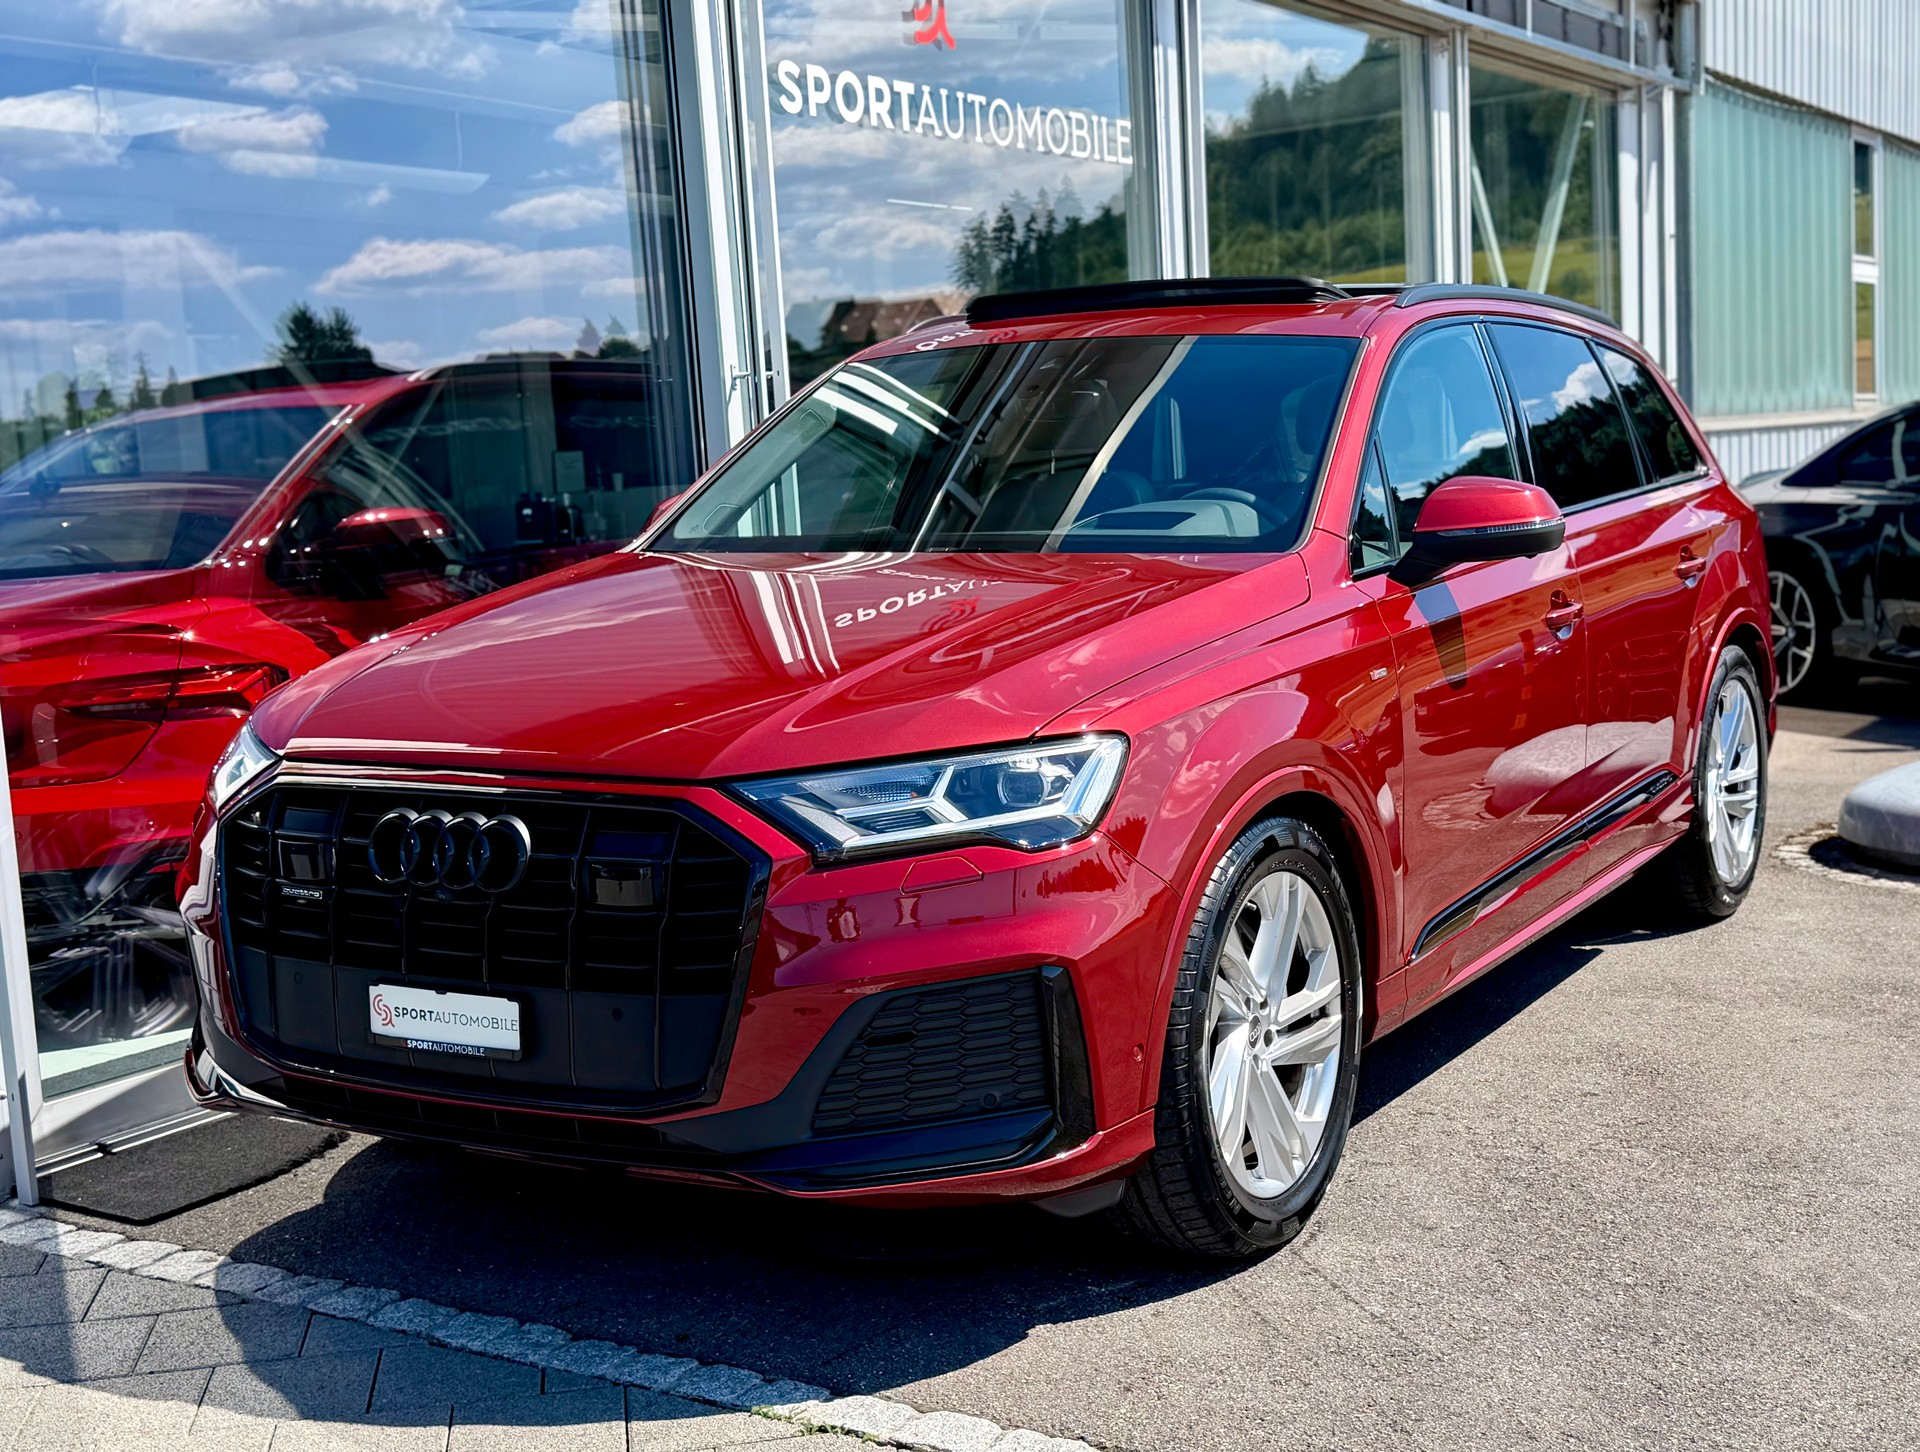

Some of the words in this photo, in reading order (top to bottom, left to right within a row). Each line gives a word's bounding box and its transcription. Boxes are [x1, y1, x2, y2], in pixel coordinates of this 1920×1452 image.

[776, 59, 1132, 165] SPORTAUTOMOBILE
[394, 1006, 518, 1032] SPORTAUTOMOBILE
[406, 1039, 486, 1057] SPORTAUTOMOBILE
